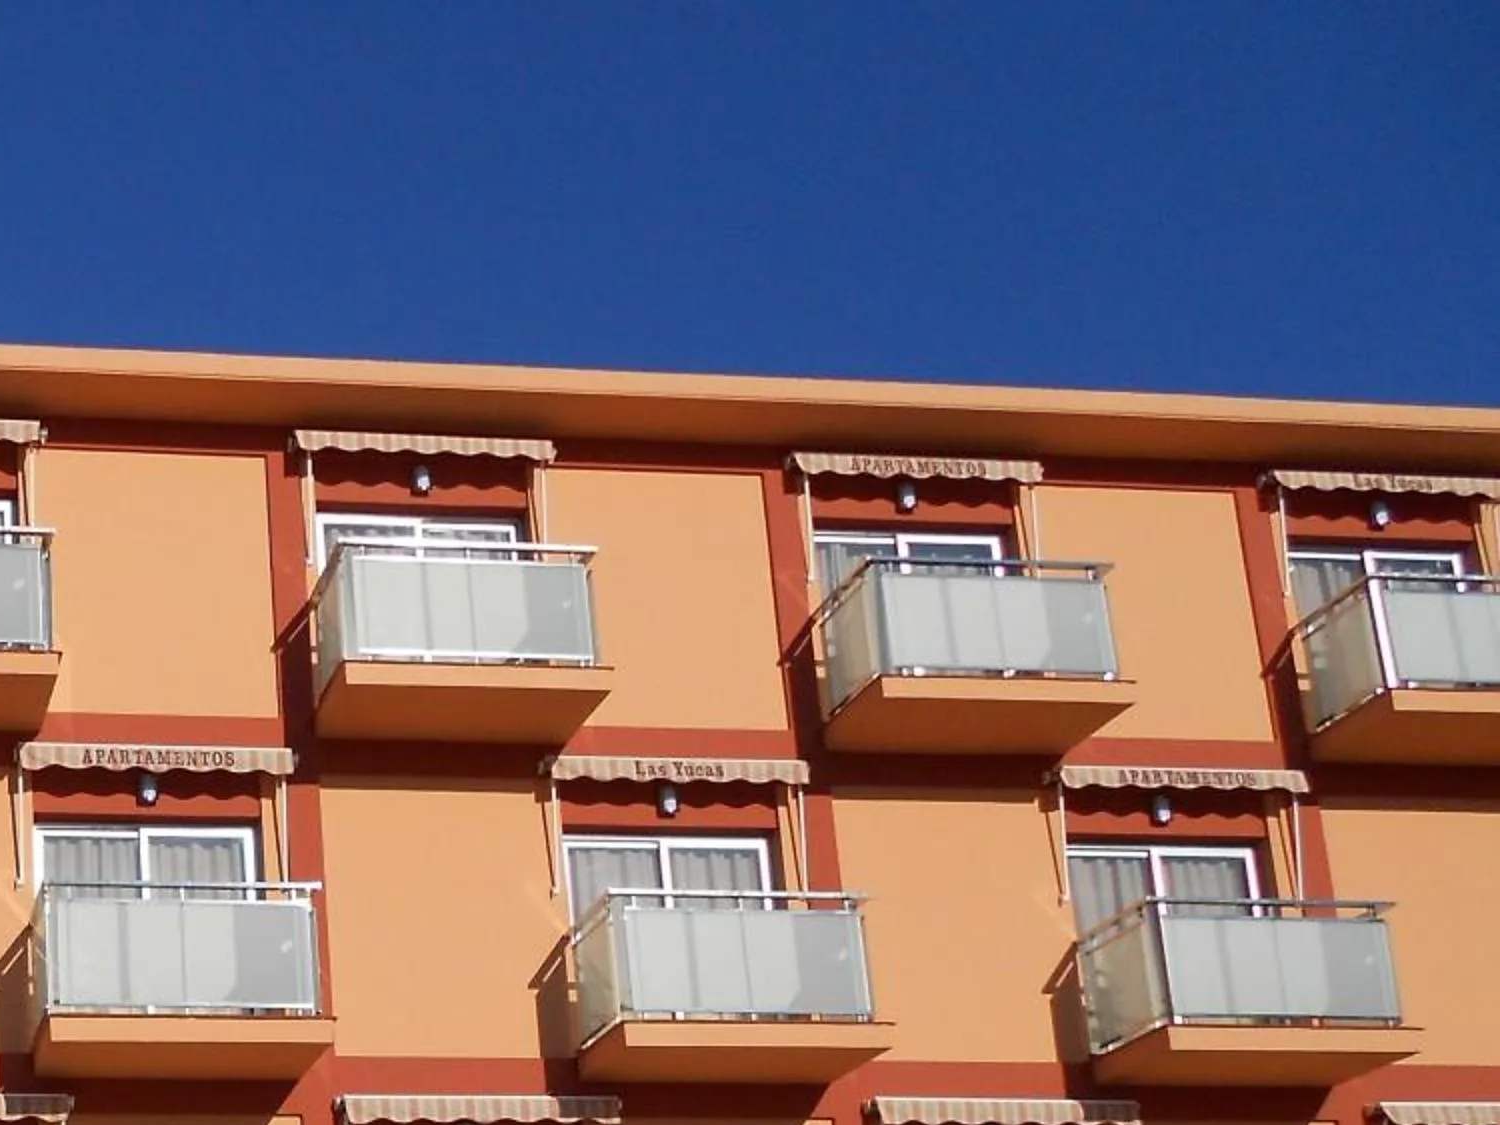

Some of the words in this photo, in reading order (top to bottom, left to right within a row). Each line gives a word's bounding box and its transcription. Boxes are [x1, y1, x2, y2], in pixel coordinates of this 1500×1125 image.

[851, 456, 987, 476] APARTAMENTOS
[81, 748, 236, 767] APARTAMENTOS
[633, 760, 667, 777] Las
[672, 761, 725, 778] Yucas
[1118, 769, 1257, 786] APARTAMENTOS
